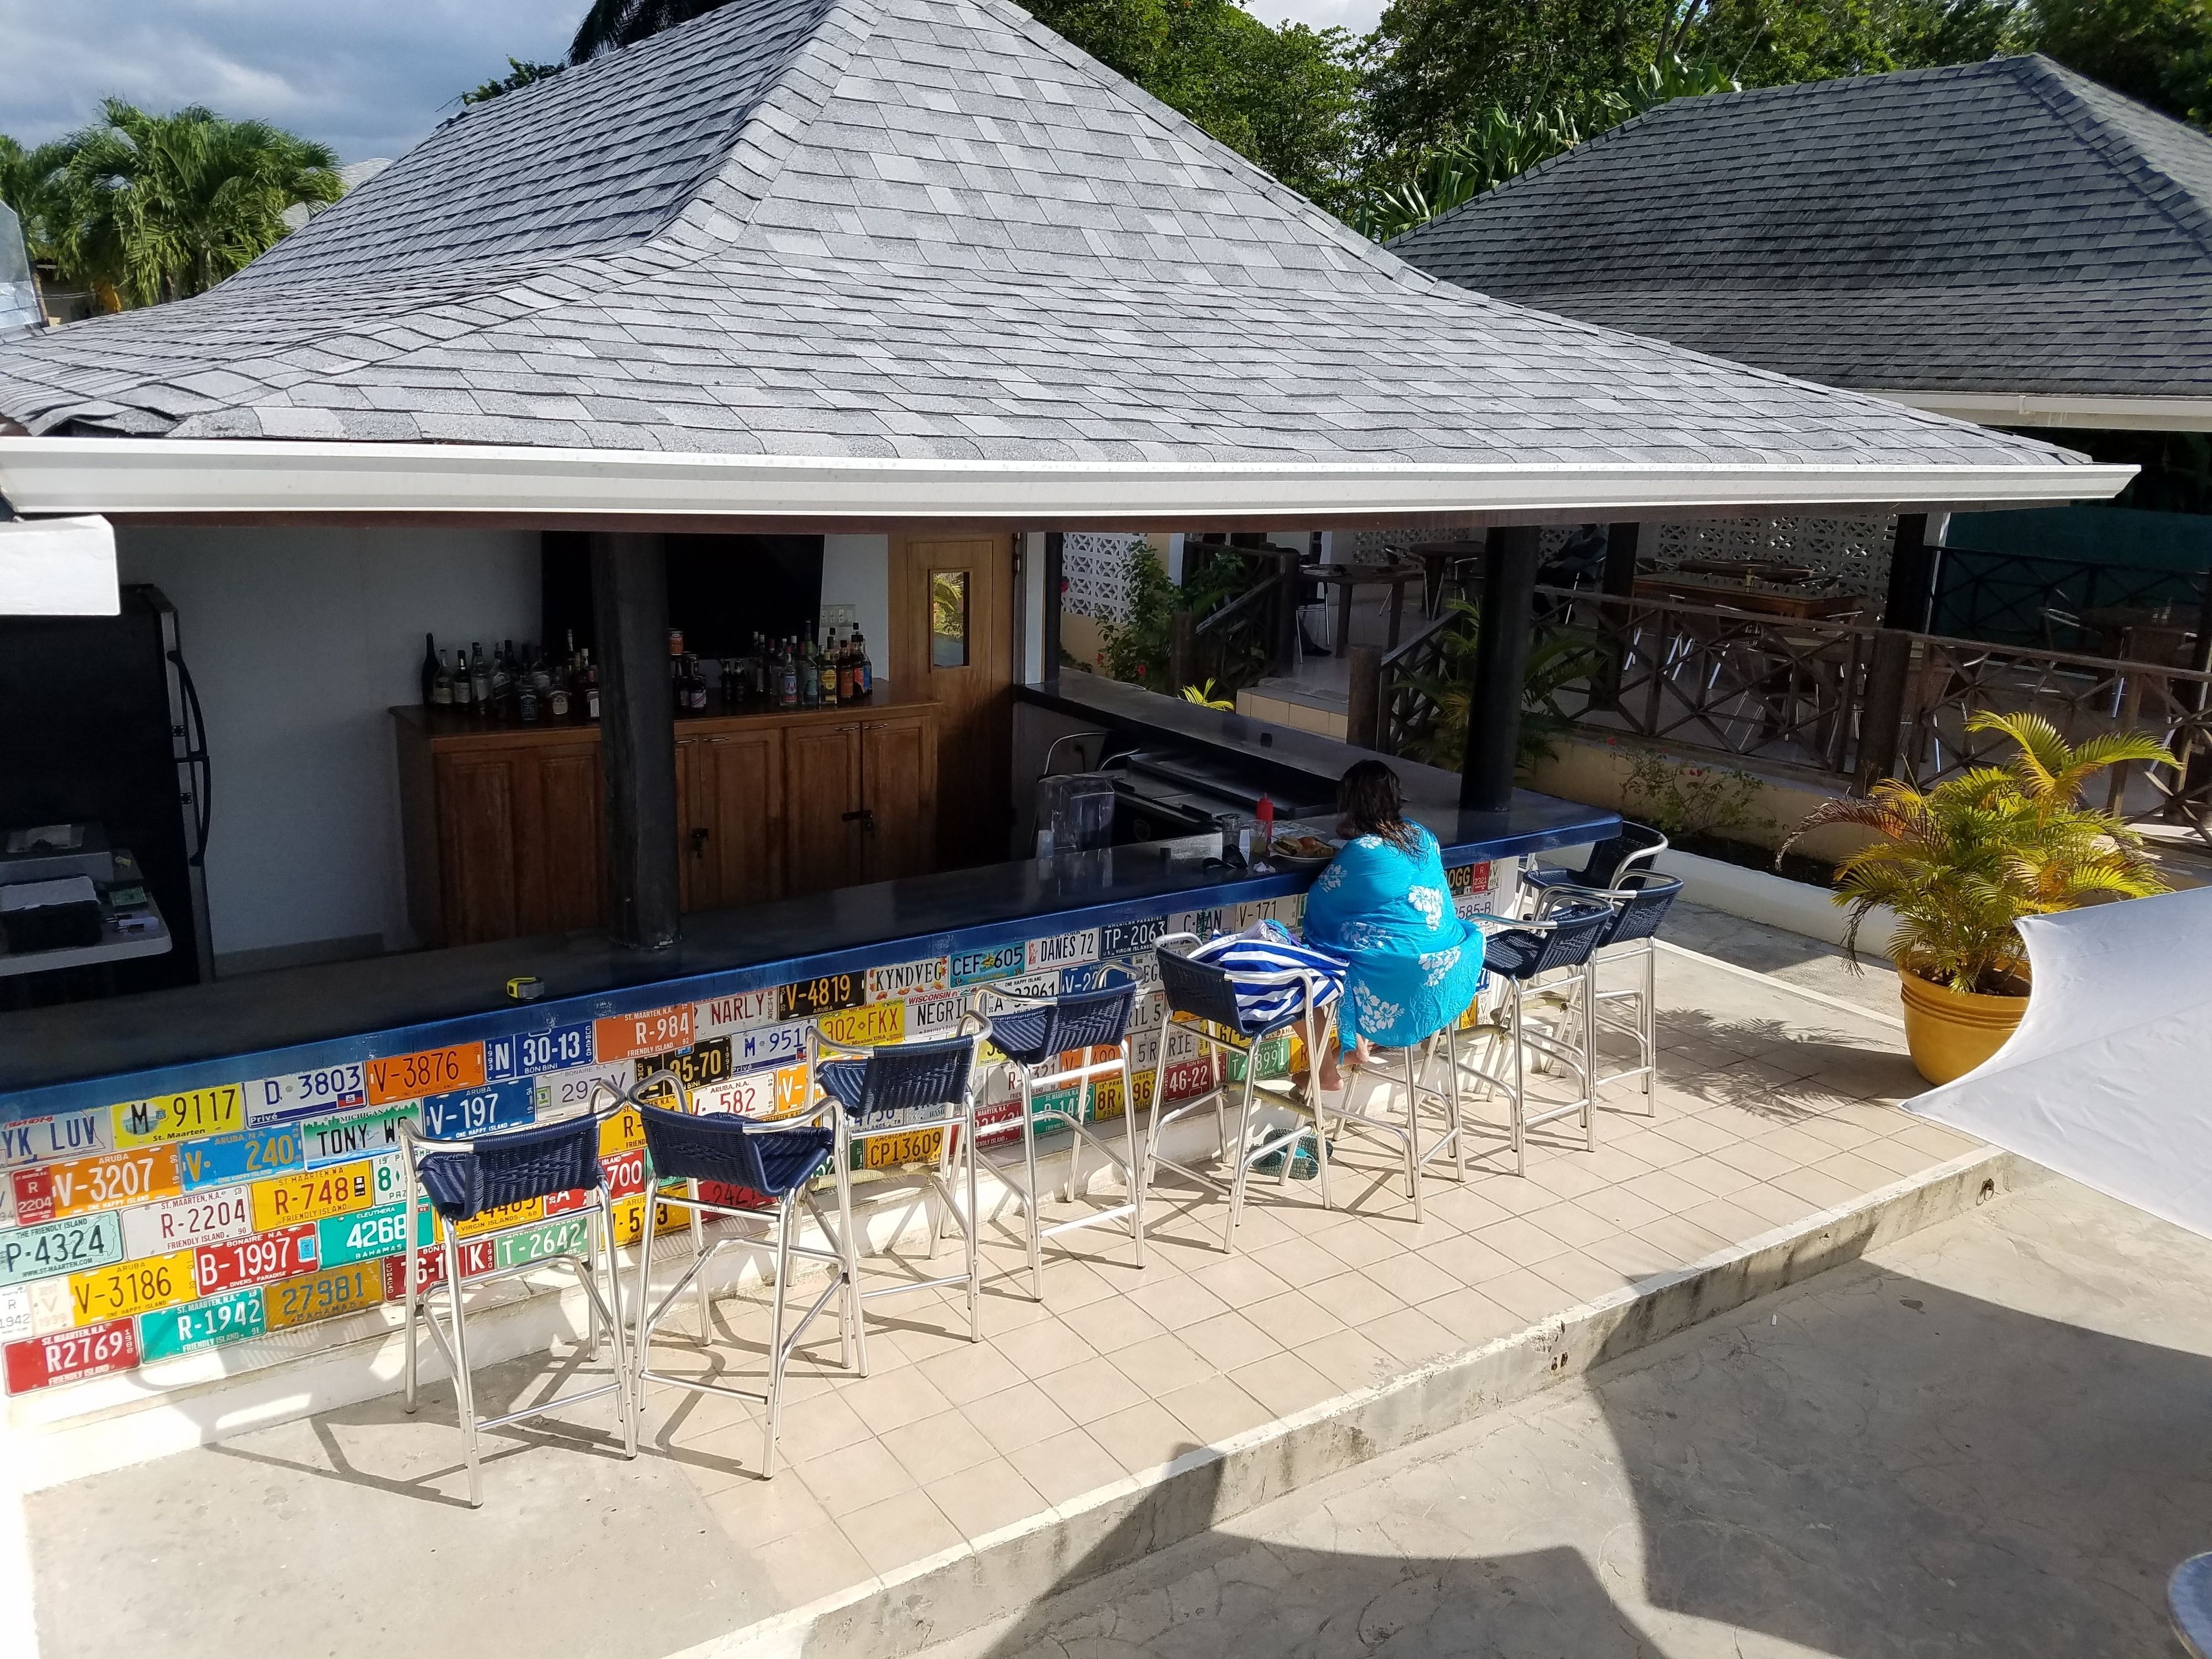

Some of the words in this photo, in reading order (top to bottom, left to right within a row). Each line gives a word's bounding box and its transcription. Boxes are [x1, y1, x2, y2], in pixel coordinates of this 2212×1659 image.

[1479, 866, 1484, 874] R
[1474, 876, 1487, 885] 2321
[1137, 915, 1162, 924] PARADISE
[1239, 900, 1277, 927] V-171
[1104, 922, 1165, 950] TP-2063
[1040, 937, 1076, 962] DANES
[1080, 932, 1094, 955] 72
[1115, 946, 1132, 955] VIRGIN
[952, 953, 982, 976] CEF
[994, 946, 1024, 968] 605
[875, 961, 942, 992] KYNDVEG
[785, 974, 851, 1010] V-4819
[908, 990, 951, 1005] WISCONSIN
[624, 1013, 634, 1021] ST.
[661, 1007, 673, 1016] N.A.
[710, 993, 764, 1026] NARLY
[812, 1005, 834, 1014] ARUBA
[635, 1012, 690, 1045] R-984
[824, 1016, 855, 1042] 302
[868, 1007, 898, 1036] FKX
[923, 1025, 945, 1033] America's
[523, 1031, 581, 1067] 30-13
[627, 1047, 654, 1058] FRIENDLY
[654, 1042, 673, 1052] ISLAND
[744, 1037, 755, 1058] M
[851, 1037, 873, 1046] Mexico
[495, 1043, 509, 1071] N
[669, 1049, 721, 1082] 35-70
[373, 1050, 459, 1093] V-3876
[524, 1066, 541, 1074] BON
[541, 1063, 558, 1071] BINI
[565, 1067, 593, 1077] BONAIRE
[1009, 1063, 1055, 1090] R-321
[264, 1080, 281, 1106] D
[298, 1065, 361, 1100] 3803
[687, 1080, 700, 1089] BINI
[1108, 1078, 1123, 1088] PANA
[1169, 1065, 1207, 1093] 46-22
[465, 1086, 492, 1096] ARUBA
[720, 1087, 756, 1114] 582
[131, 1101, 150, 1135] M
[173, 1088, 236, 1128] 9117
[249, 1112, 278, 1123] Privé
[340, 1108, 384, 1122] MICHIGAN
[429, 1093, 499, 1135] V-197
[977, 1108, 998, 1118] MAARTEN,
[1103, 1108, 1115, 1118] PAZ
[50, 1116, 94, 1152] LUV
[153, 1134, 165, 1142] St.
[166, 1128, 206, 1140] Maarten
[456, 1130, 466, 1138] ONE
[468, 1127, 487, 1136] HAPPY
[488, 1122, 507, 1132] ISLAND
[874, 1132, 907, 1142] AMERICAN
[214, 1134, 244, 1145] ARUBA
[316, 1123, 368, 1157] TONY
[870, 1131, 941, 1166] CP13609
[990, 1135, 1005, 1145] ISLAND
[99, 1153, 129, 1164] ARUBA
[170, 1154, 177, 1164] 99
[245, 1134, 294, 1171] 240
[601, 1156, 622, 1166] ISLAND
[28, 1181, 39, 1194] R
[55, 1158, 154, 1207] V-3207
[172, 1175, 180, 1185] 19
[18, 1196, 53, 1213] 2204
[87, 1201, 101, 1210] ONE
[103, 1198, 124, 1208] HAPPY
[127, 1194, 150, 1205] ISLAND
[161, 1201, 172, 1210] ST.
[172, 1196, 207, 1209] MAARTEN,
[207, 1192, 222, 1201] N.A.
[274, 1176, 349, 1215] R-748
[626, 1195, 647, 1207] ARUB
[161, 1198, 246, 1238] R-2204
[282, 1210, 317, 1224] FRIENDLY
[319, 1203, 347, 1215] ISLAND
[356, 1206, 396, 1219] ELEUTHERA
[15, 1230, 29, 1239] THE
[31, 1223, 63, 1237] FRIENDLY
[63, 1218, 88, 1230] ISLAND
[237, 1226, 247, 1235] 90
[461, 1221, 485, 1232] VIRGIN
[488, 1215, 518, 1226] ISLANDS
[167, 1236, 199, 1250] FRIENDLY
[226, 1235, 263, 1248] BONAIRE
[268, 1230, 284, 1238] N.A.
[502, 1219, 588, 1265] T-2642
[6, 1225, 104, 1273] P-4324
[355, 1244, 402, 1259] BAHAMAS
[423, 1246, 440, 1255] BON
[469, 1243, 486, 1272] K
[116, 1262, 146, 1273] ARUBA
[200, 1236, 290, 1286] B-1997
[229, 1278, 252, 1288] DIVERS
[256, 1270, 287, 1282] PARADISE
[386, 1263, 394, 1294] CURACAO
[74, 1266, 172, 1315] V-3186
[282, 1271, 364, 1317] 27981
[8, 1299, 16, 1310] R
[106, 1310, 118, 1319] ONE
[121, 1305, 142, 1315] HAPPY
[145, 1300, 166, 1309] ISLAND
[188, 1298, 223, 1312] MAARTEN,
[223, 1294, 237, 1304] N.A.
[297, 1301, 357, 1321] BAHAMAS
[177, 1298, 262, 1342] R-1942
[251, 1327, 260, 1335] 91
[41, 1336, 55, 1346] ST.
[124, 1329, 134, 1354] 1988
[182, 1338, 215, 1353] FRIENDLY
[216, 1332, 240, 1344] ISLAND
[46, 1331, 123, 1374] R2769
[48, 1370, 82, 1386] FRIENDLY
[83, 1363, 110, 1377] ISLAND
